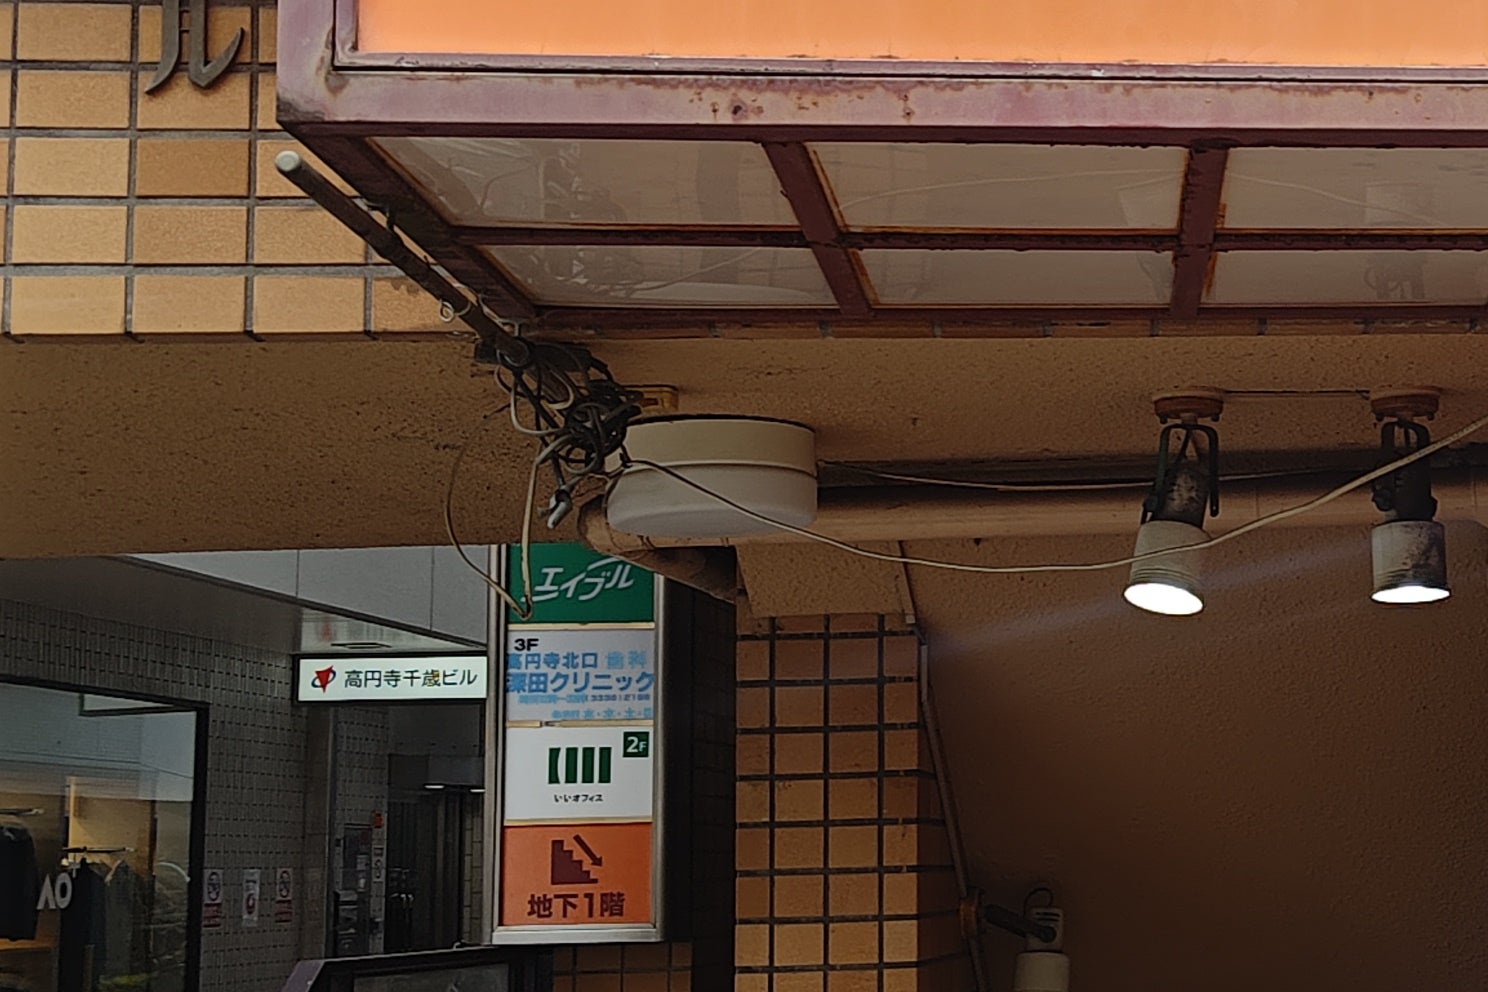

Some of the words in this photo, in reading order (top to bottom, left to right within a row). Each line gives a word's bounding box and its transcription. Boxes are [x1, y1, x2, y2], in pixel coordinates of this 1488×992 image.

[533, 563, 635, 601] エイブル
[514, 638, 539, 651] 3F
[344, 668, 478, 689] 高円寺千歳ビル
[626, 736, 647, 753] 2F
[553, 794, 604, 803] いいオフィス
[527, 892, 625, 919] 地下1階
